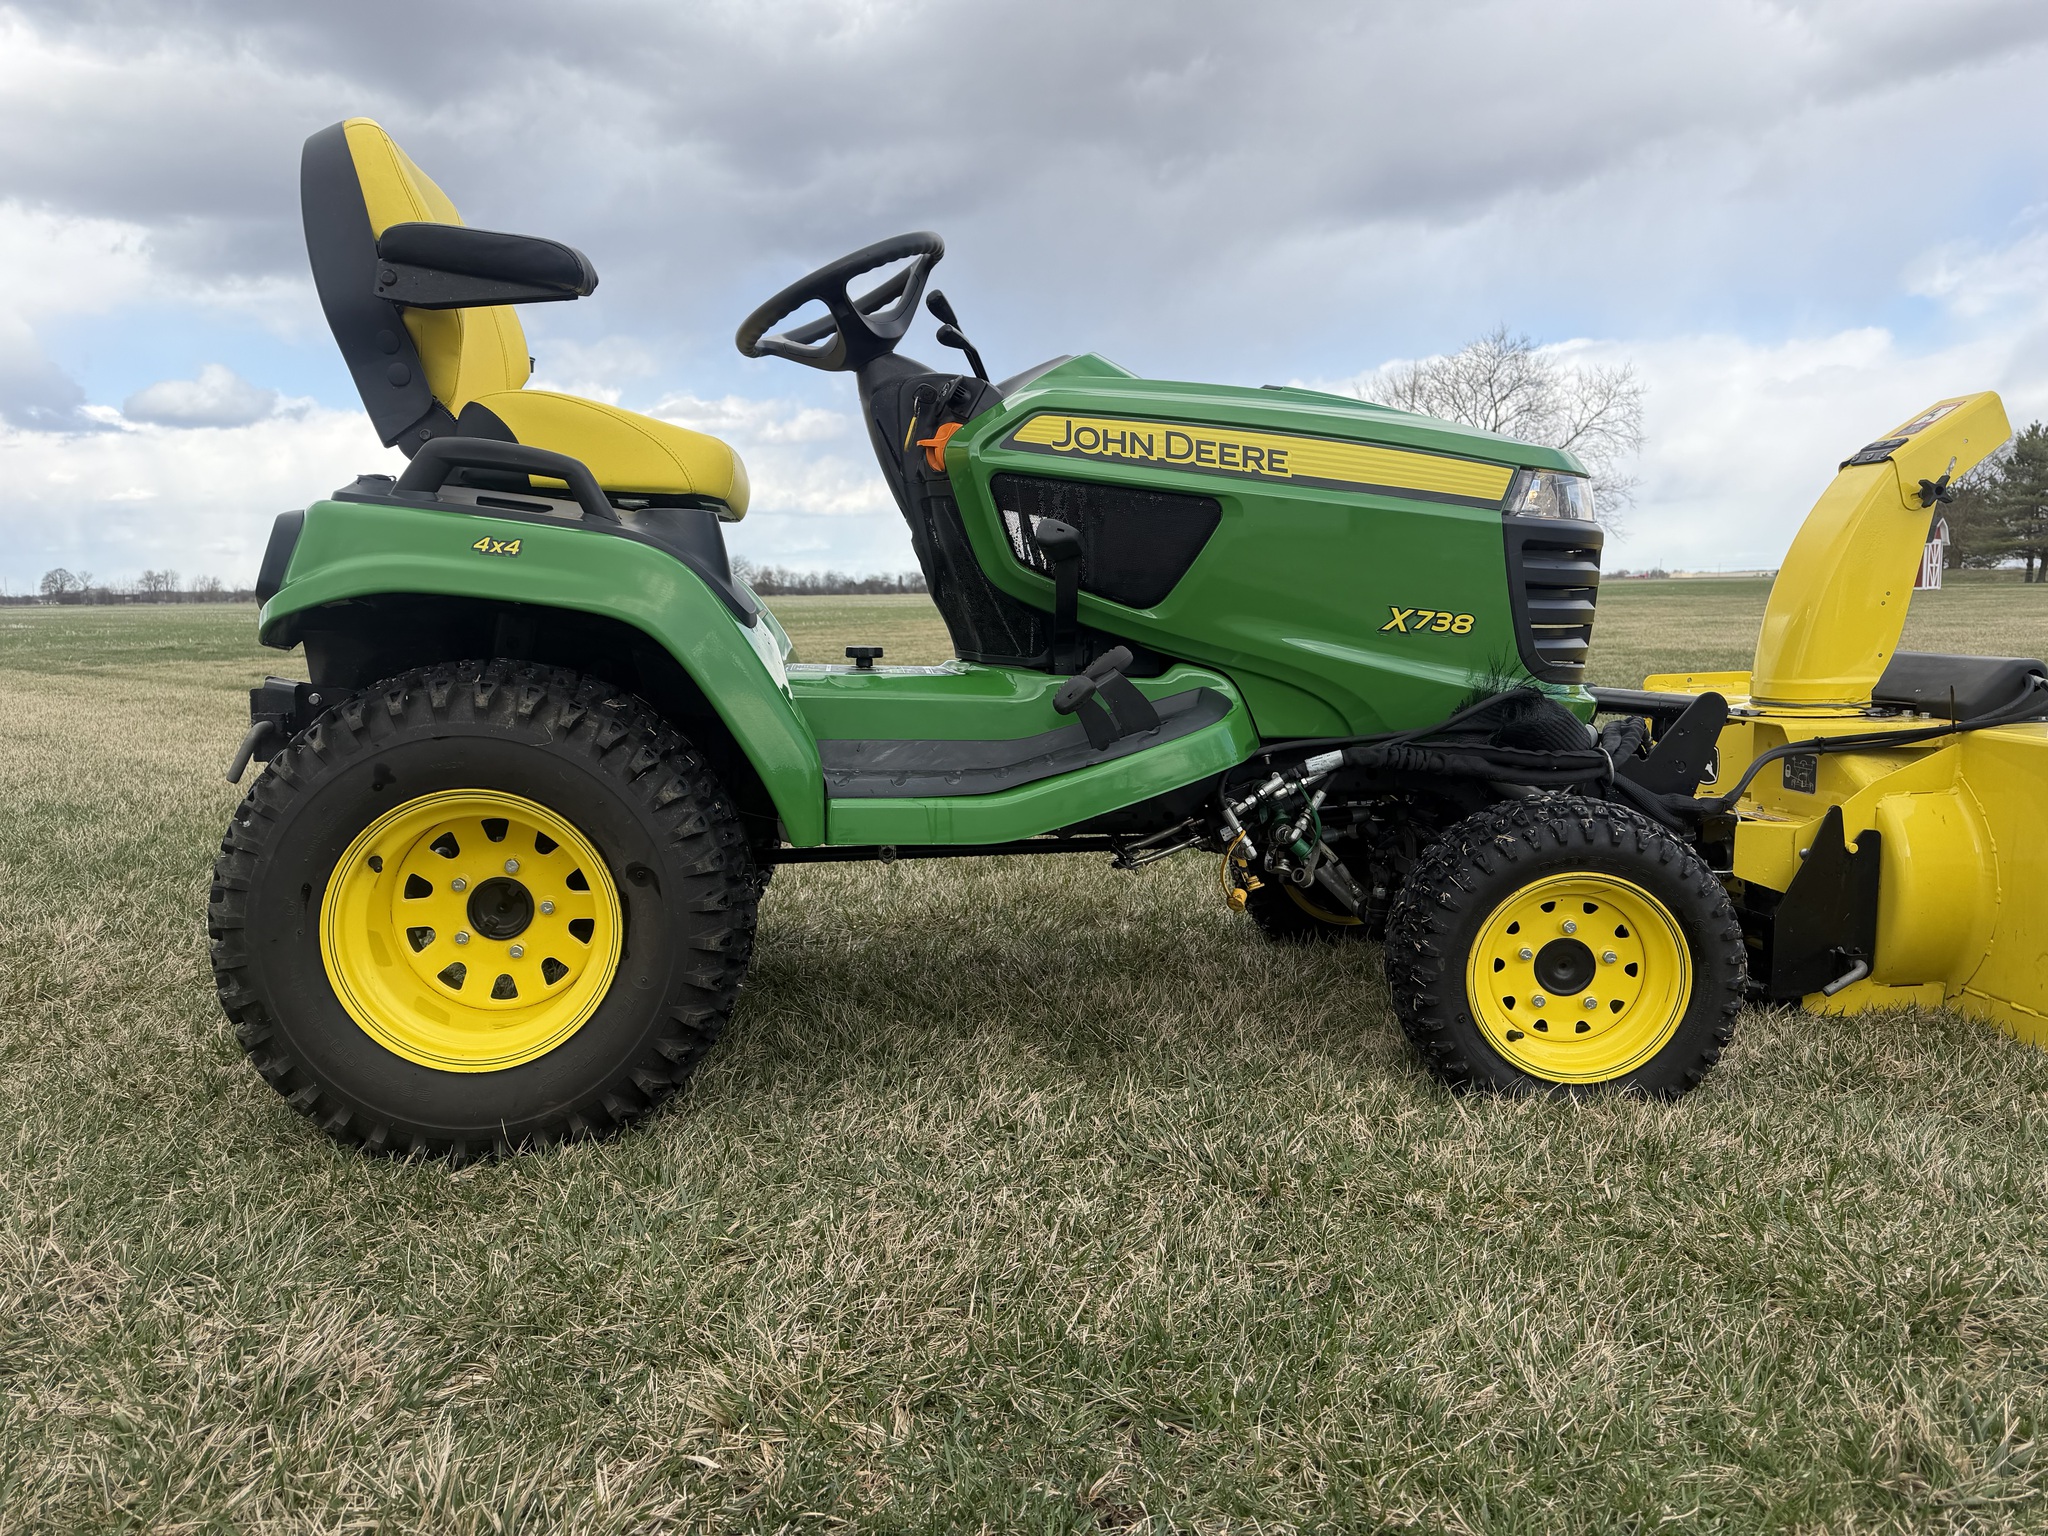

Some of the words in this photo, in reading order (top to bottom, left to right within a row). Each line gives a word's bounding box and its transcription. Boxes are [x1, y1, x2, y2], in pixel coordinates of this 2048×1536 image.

[1051, 419, 1154, 456] JOHN
[1164, 430, 1289, 474] DEERE
[473, 536, 521, 555] 4x4
[1381, 606, 1475, 634] X738
